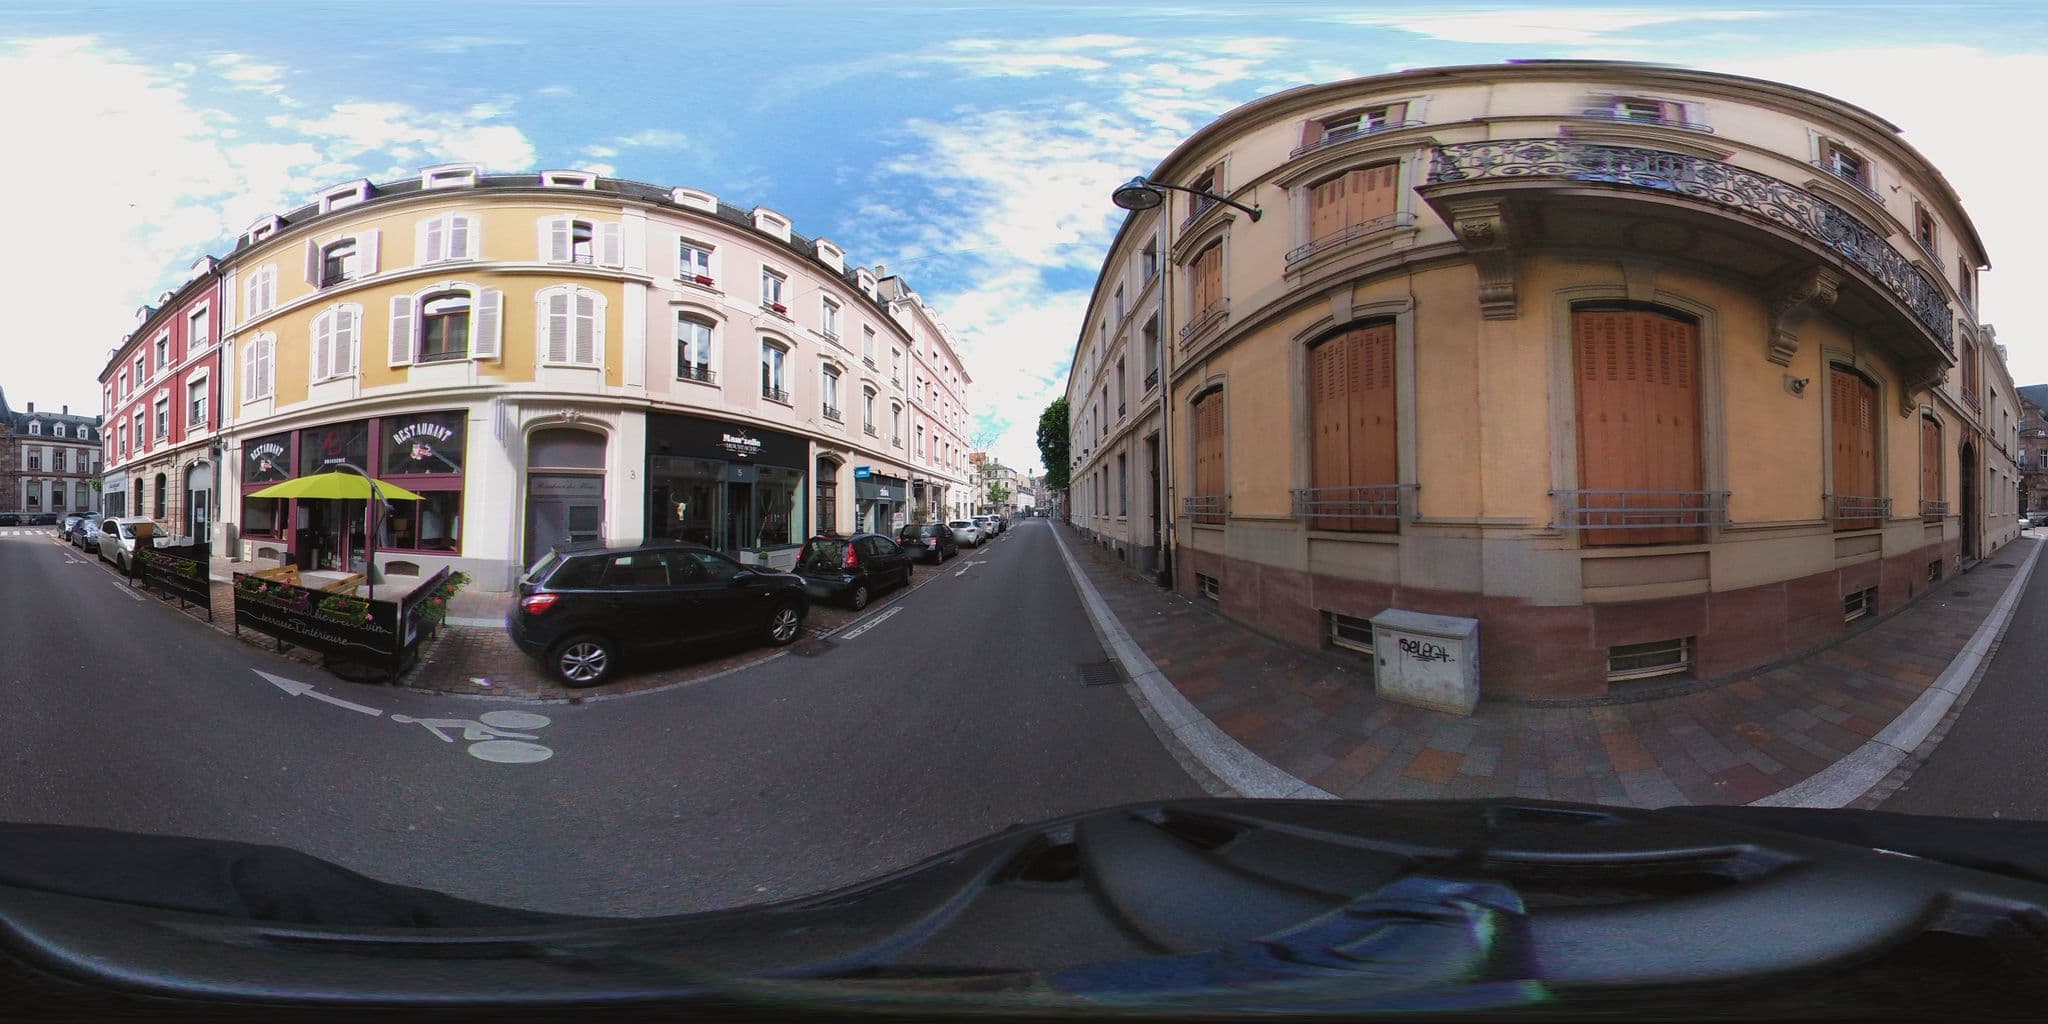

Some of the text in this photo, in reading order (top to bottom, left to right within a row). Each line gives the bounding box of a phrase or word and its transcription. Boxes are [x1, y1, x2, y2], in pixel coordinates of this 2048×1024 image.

[393, 423, 452, 445] RESTAURANT
[250, 443, 284, 460] RESTAURANT
[630, 470, 637, 480] 3
[737, 469, 743, 477] 5
